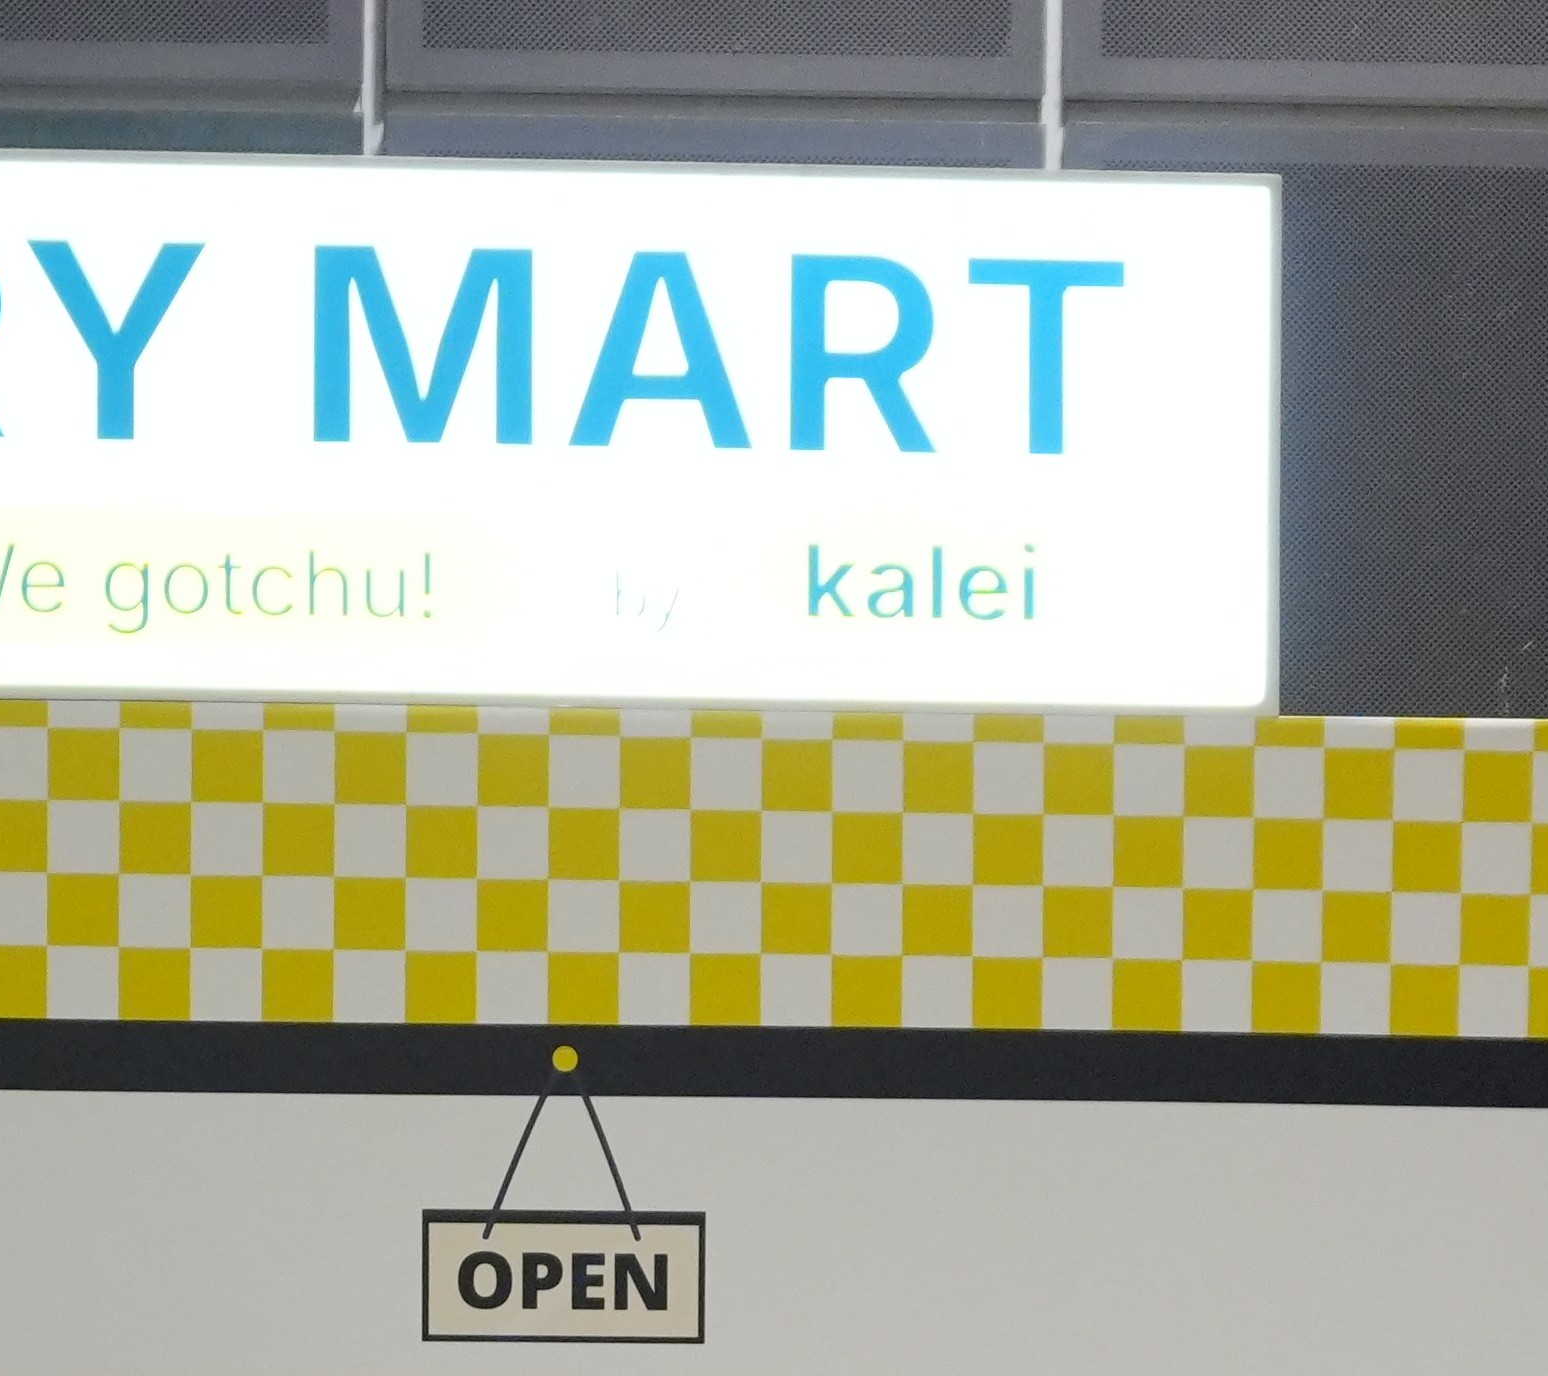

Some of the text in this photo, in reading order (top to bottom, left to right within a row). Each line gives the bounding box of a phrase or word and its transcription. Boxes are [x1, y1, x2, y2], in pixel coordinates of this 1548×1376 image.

[310, 243, 1126, 457] MART
[103, 548, 434, 633] gotchu!
[807, 542, 1035, 621] kalei
[455, 1250, 670, 1311] OPEN
